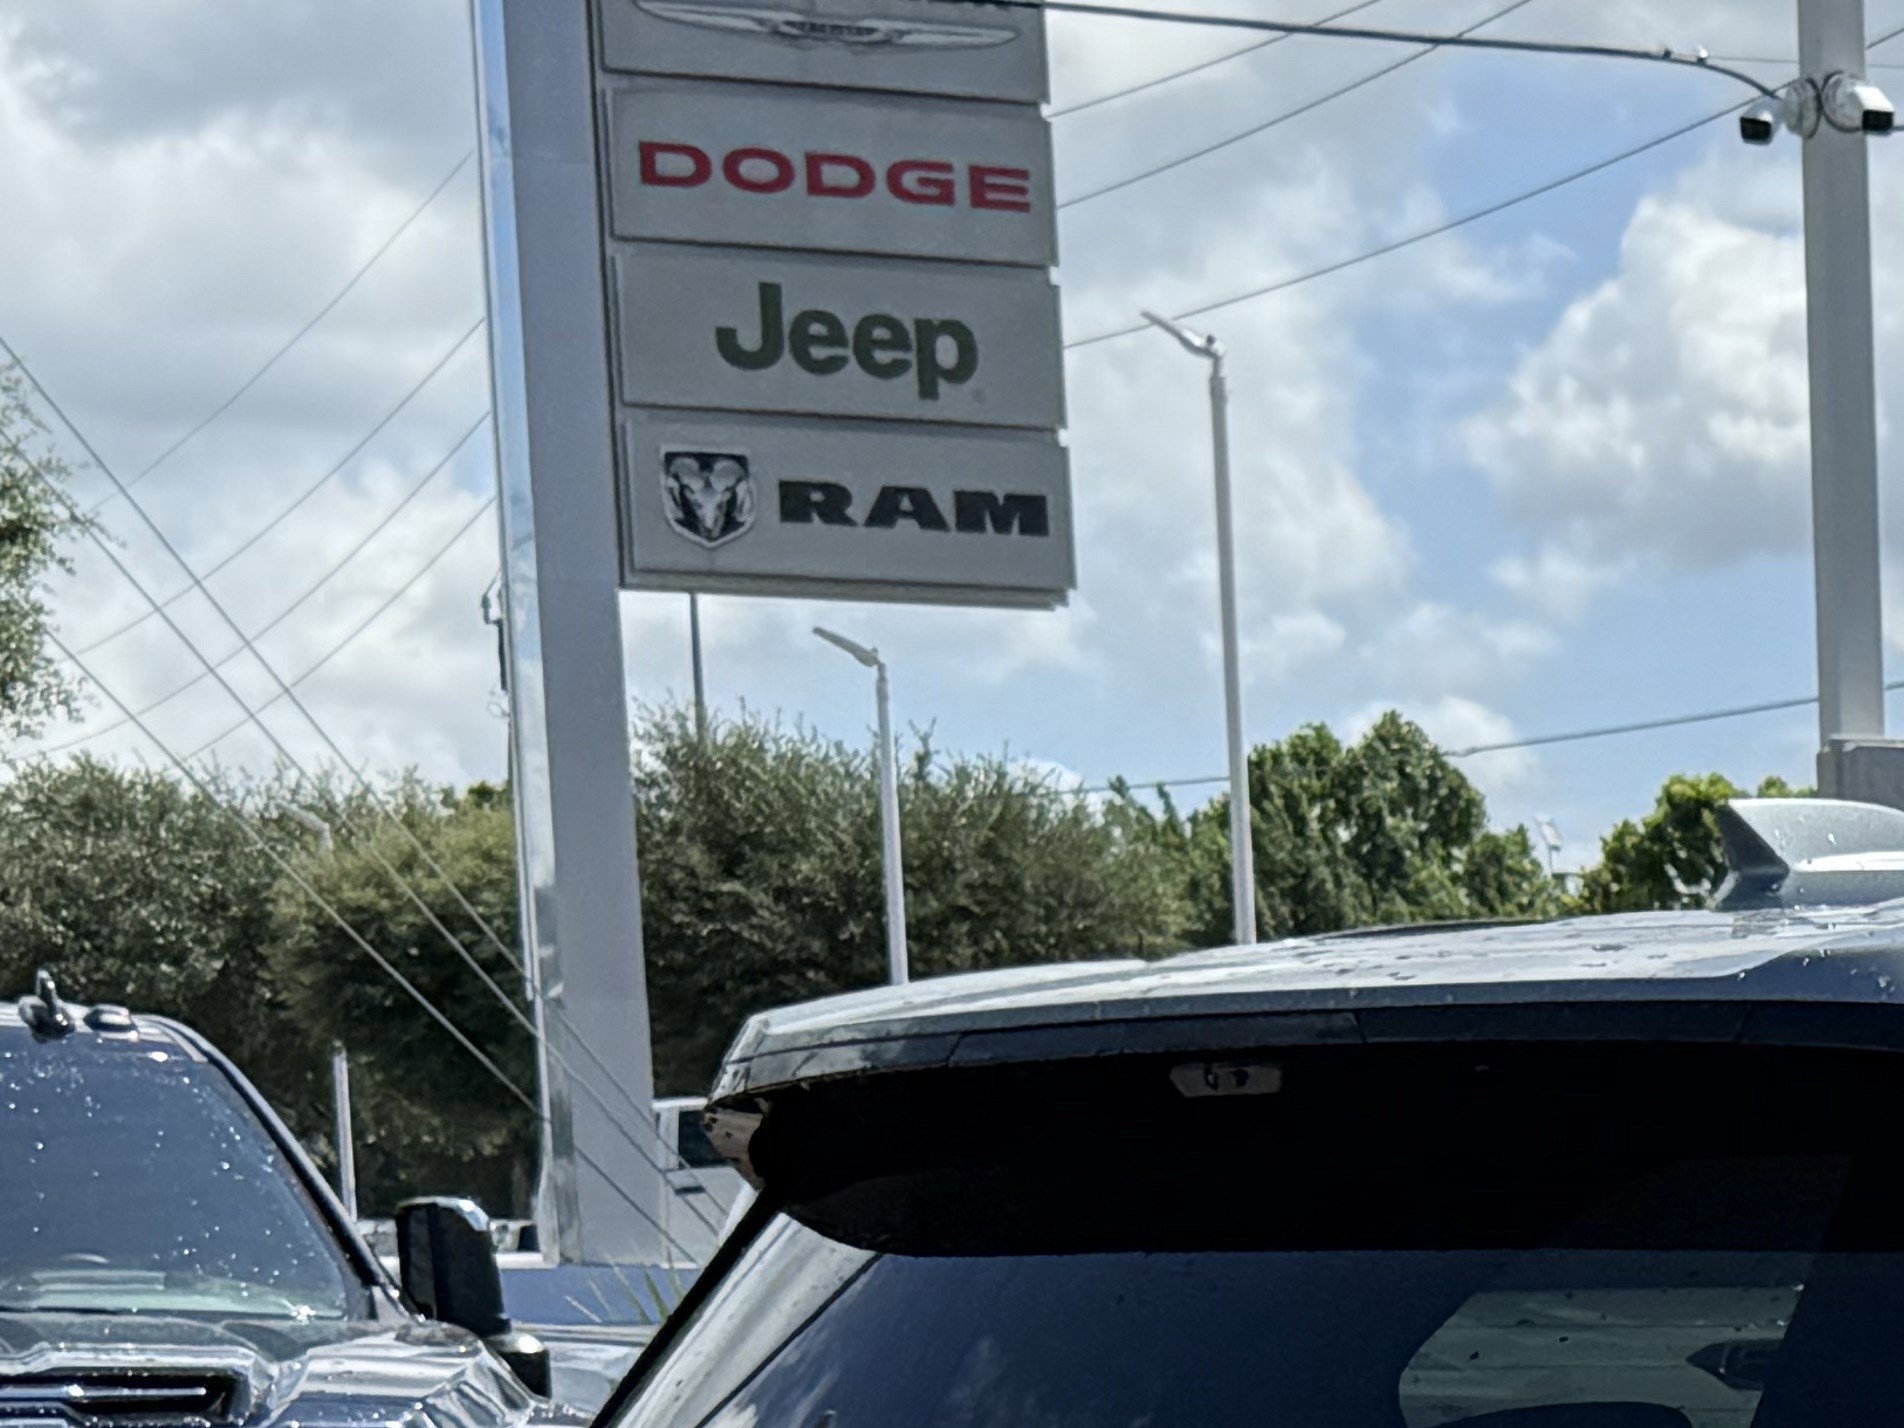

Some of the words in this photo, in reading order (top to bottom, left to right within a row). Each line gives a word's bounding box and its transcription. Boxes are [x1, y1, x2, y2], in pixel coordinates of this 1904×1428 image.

[638, 140, 1032, 213] DODGE
[715, 281, 979, 400] Jeep
[777, 480, 1050, 537] RAM
